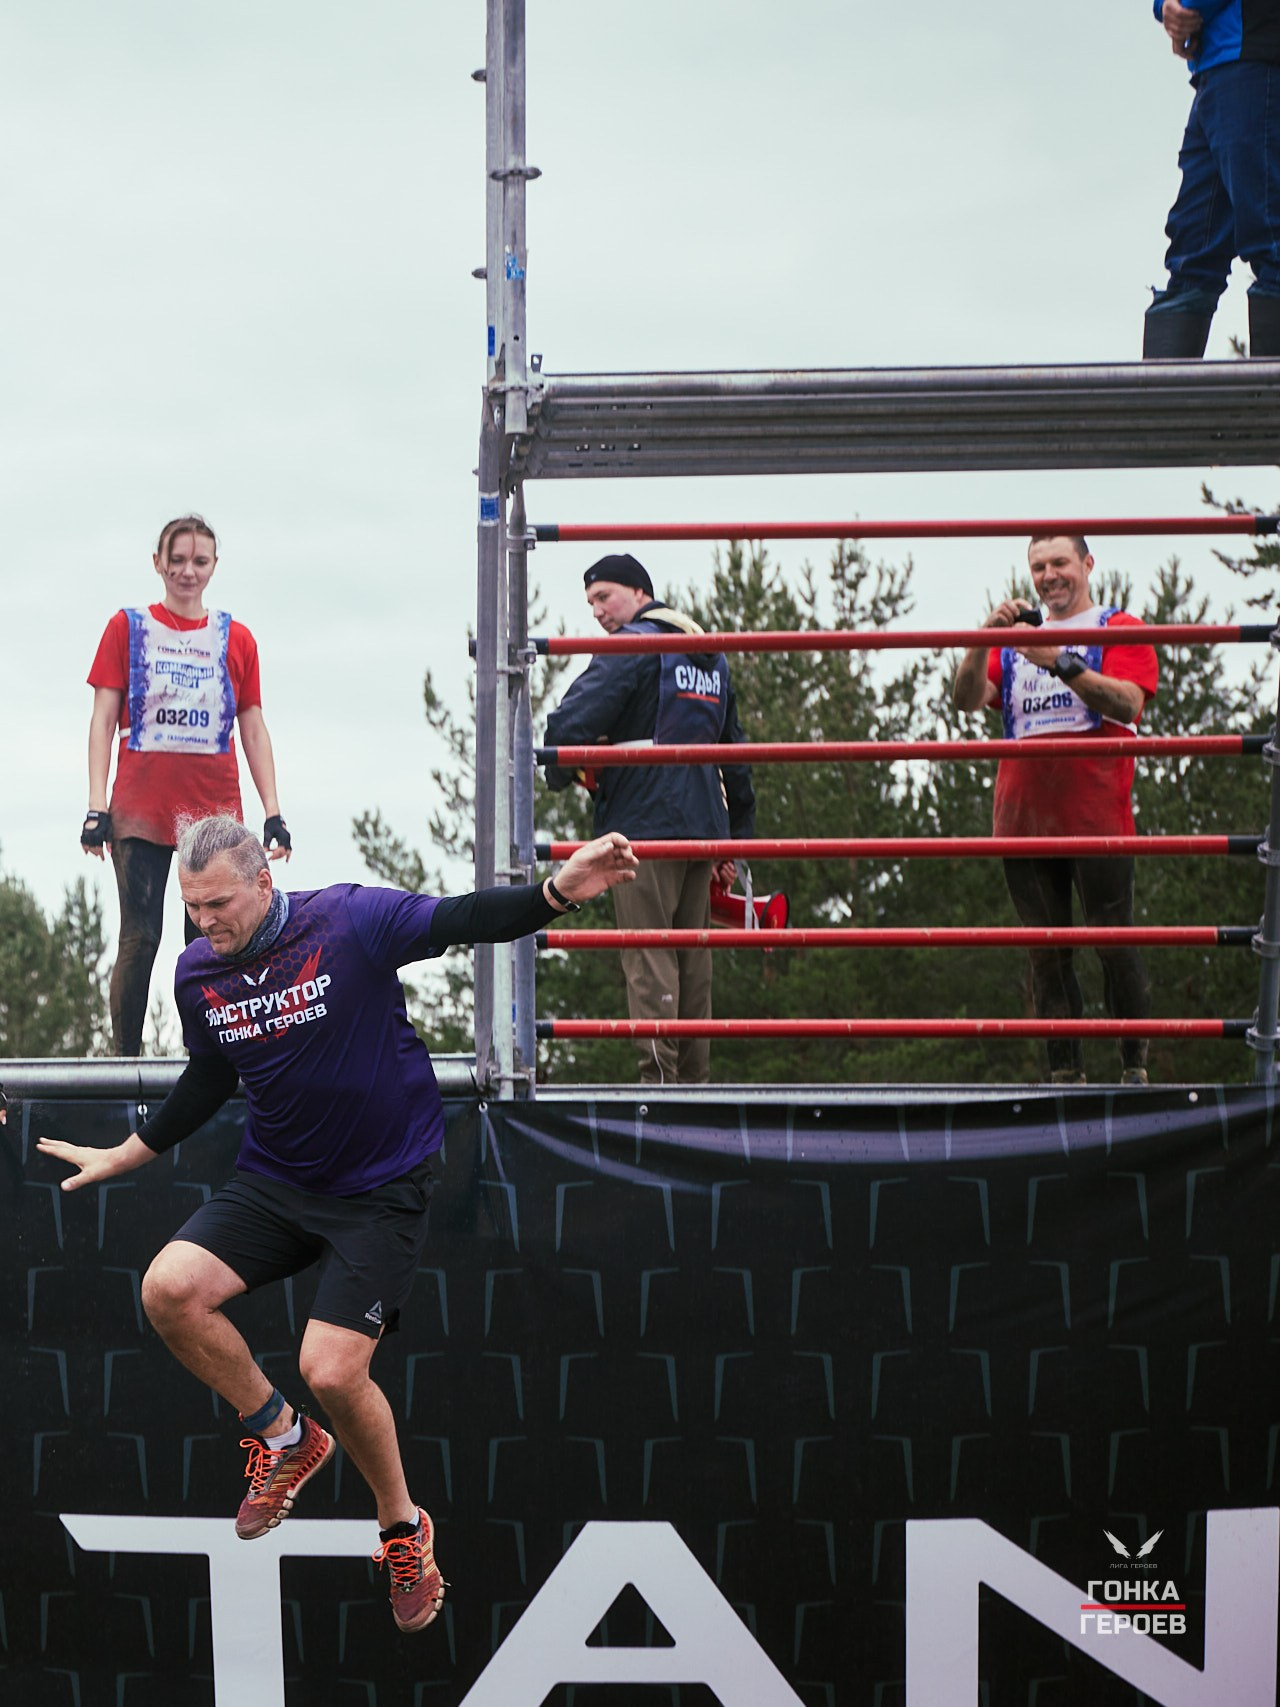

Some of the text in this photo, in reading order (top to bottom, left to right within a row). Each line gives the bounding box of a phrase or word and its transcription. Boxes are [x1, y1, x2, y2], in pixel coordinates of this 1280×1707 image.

[675, 665, 720, 695] СУДЬЯ
[156, 708, 210, 727] 03209
[206, 974, 332, 1027] ИНСТРУКТОР
[219, 1003, 328, 1044] ГОНКА ГЕРОЕВ
